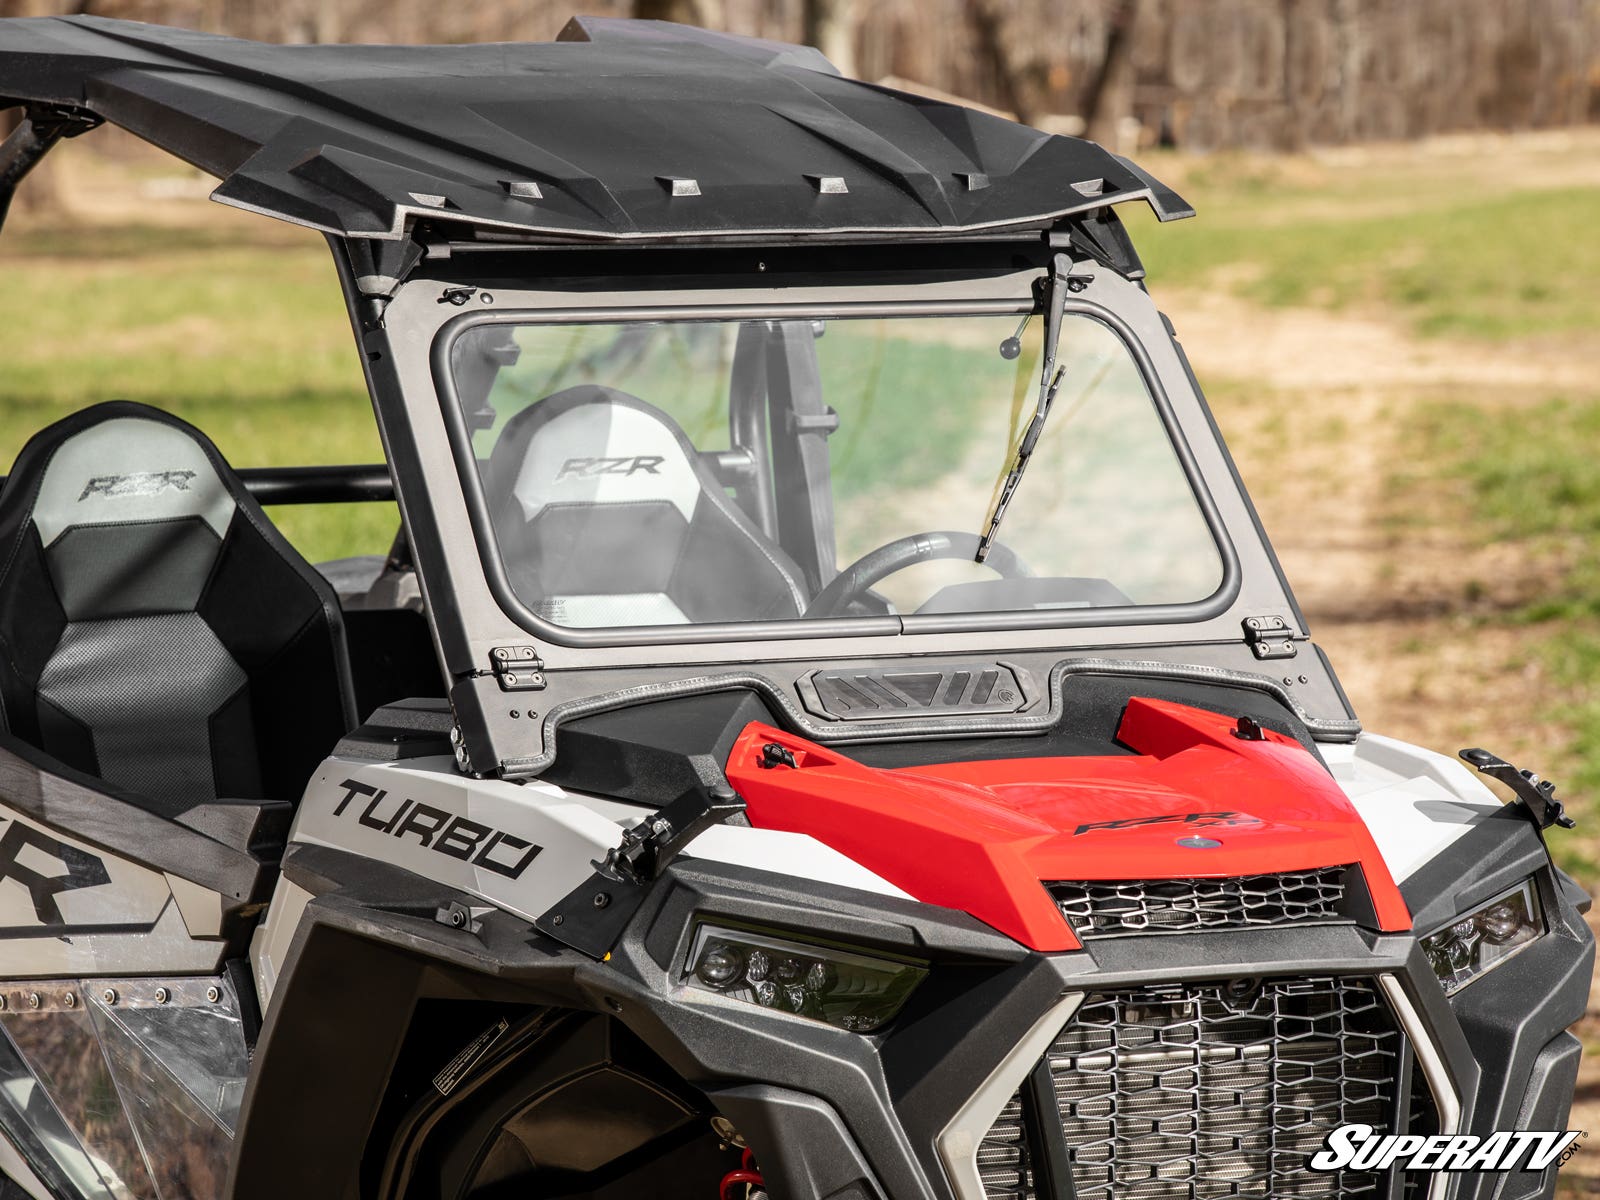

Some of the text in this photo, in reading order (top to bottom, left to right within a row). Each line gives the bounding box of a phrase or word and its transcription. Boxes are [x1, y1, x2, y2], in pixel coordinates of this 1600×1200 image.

[554, 456, 665, 481] RZR
[0, 817, 112, 925] R
[332, 778, 544, 880] TURBO
